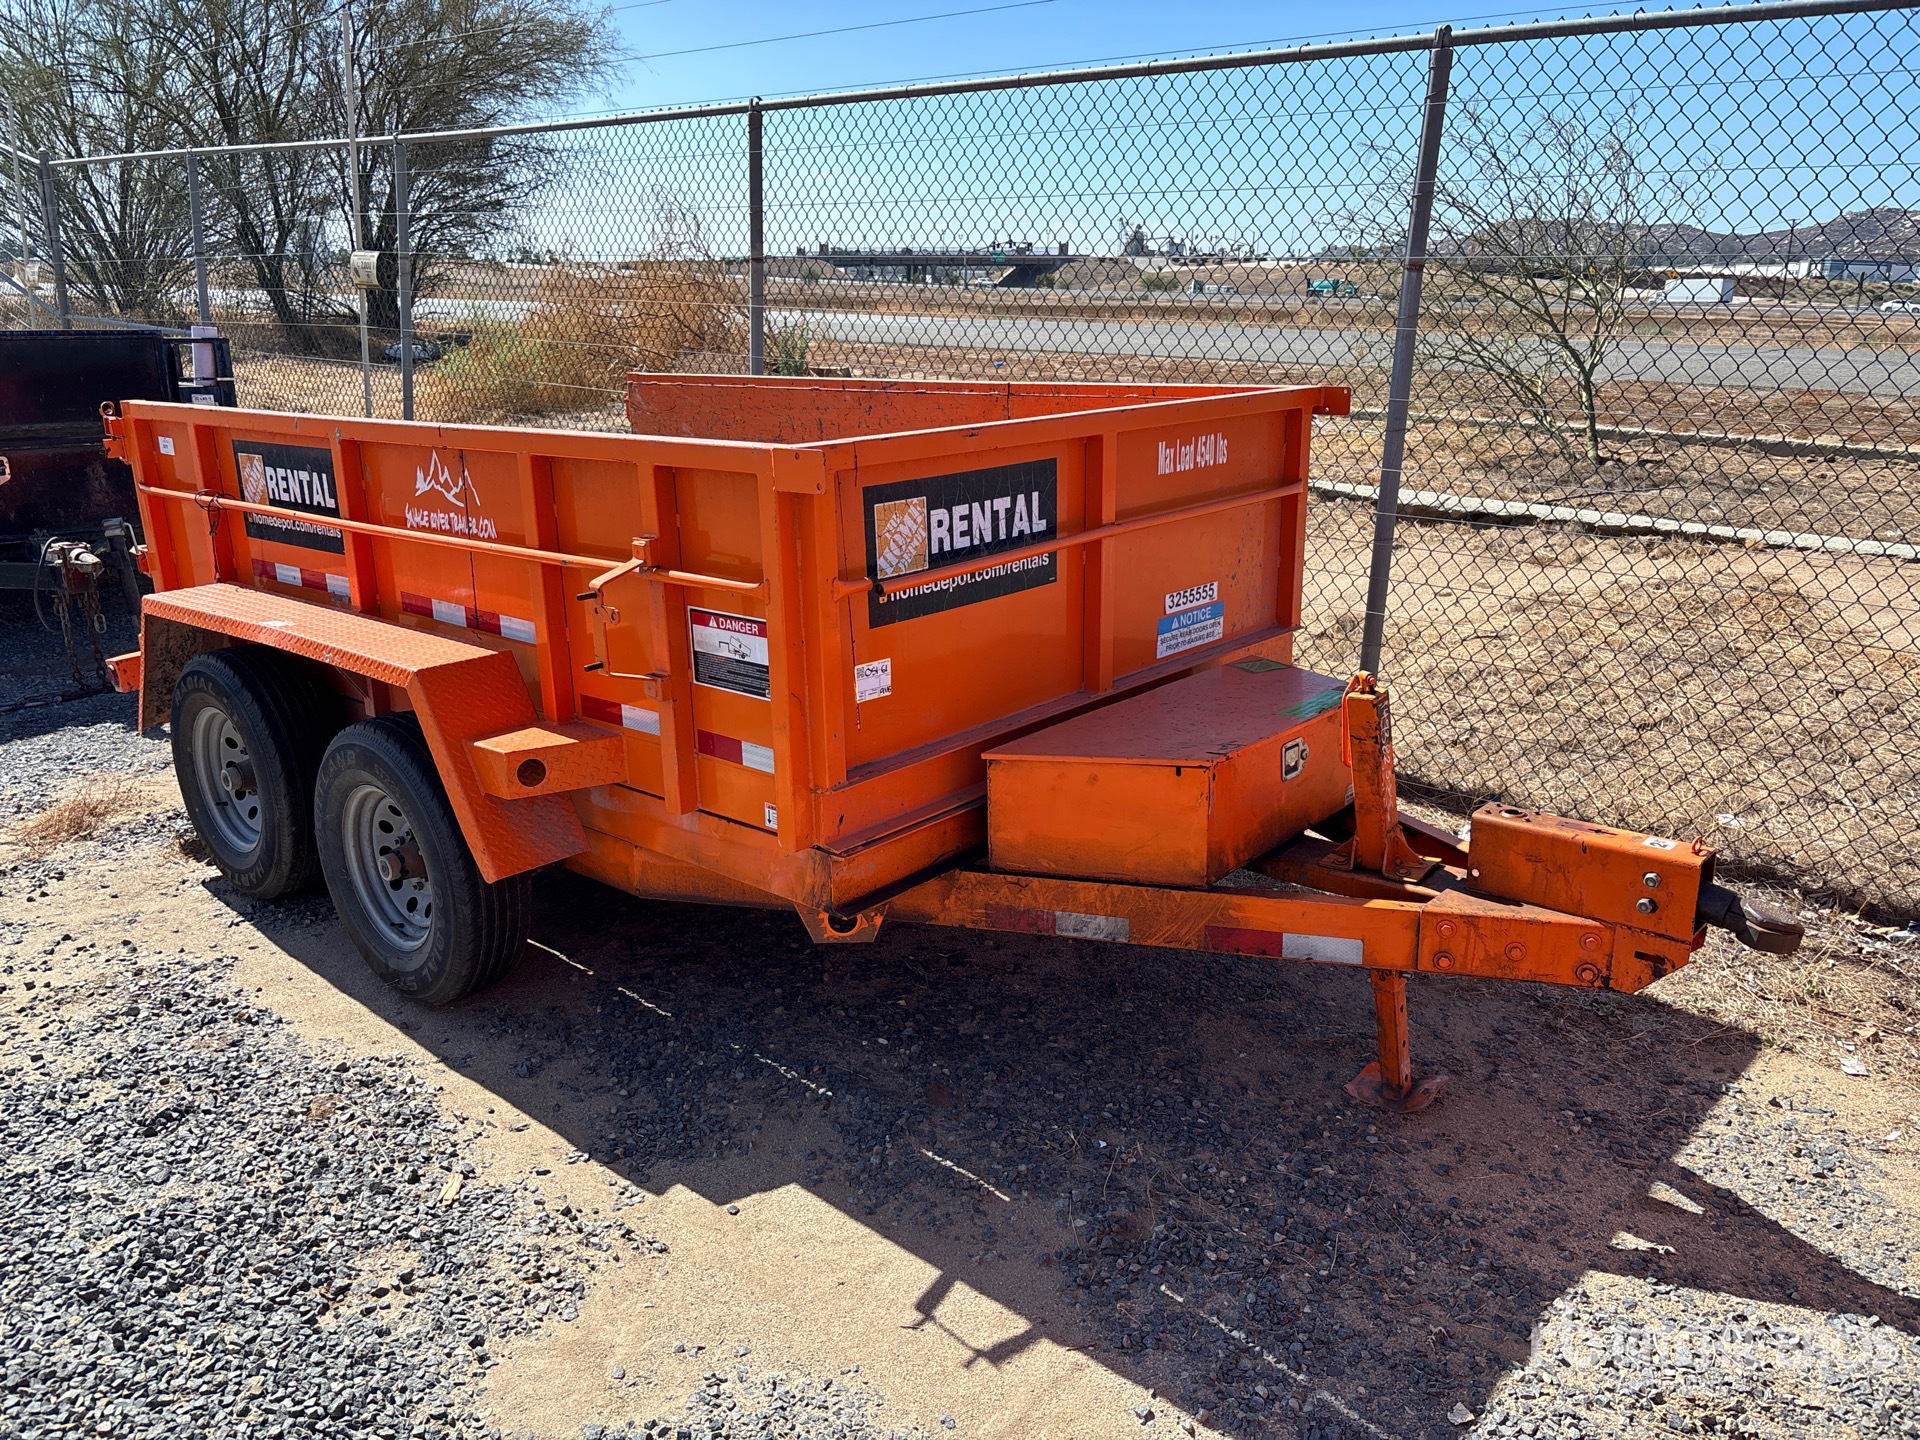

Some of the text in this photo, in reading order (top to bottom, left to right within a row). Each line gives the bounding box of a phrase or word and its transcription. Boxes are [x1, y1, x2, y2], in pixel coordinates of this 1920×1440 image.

[1158, 432, 1228, 475] Max Load 4540 lbs
[265, 466, 336, 508] RENTAL
[930, 491, 1047, 554] RENTAL
[1168, 582, 1215, 609] 3255555
[719, 617, 759, 635] DANGER
[1180, 606, 1212, 627] NOTICE
[1160, 633, 1179, 645] SECURE
[1192, 623, 1208, 634] DOORS
